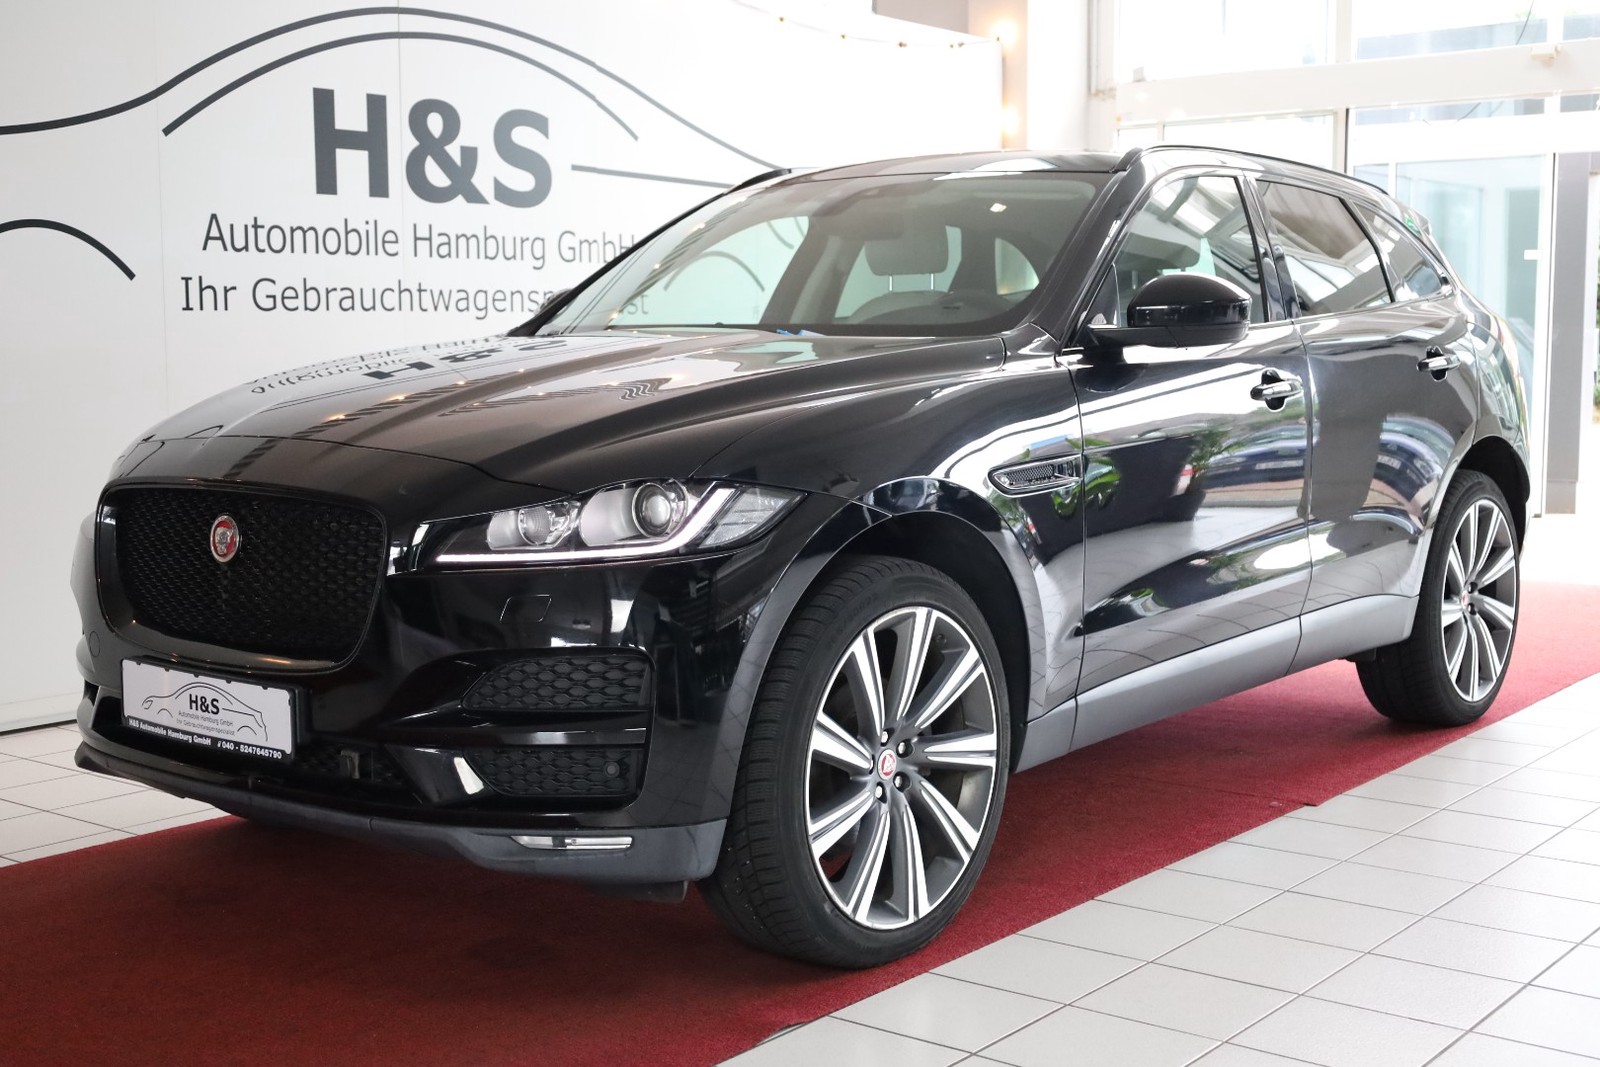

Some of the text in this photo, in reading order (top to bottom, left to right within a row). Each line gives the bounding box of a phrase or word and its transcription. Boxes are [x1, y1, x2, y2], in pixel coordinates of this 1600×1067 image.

[312, 87, 552, 208] H&S
[202, 213, 399, 257] Automobile
[413, 222, 546, 270] Hamburg
[181, 276, 237, 311] Ihr
[189, 693, 220, 715] H&S
[128, 718, 139, 728] H&S
[140, 721, 167, 736] Automobile
[167, 728, 193, 743] Hamburg
[193, 735, 212, 746] GmbH
[222, 741, 234, 750] 040
